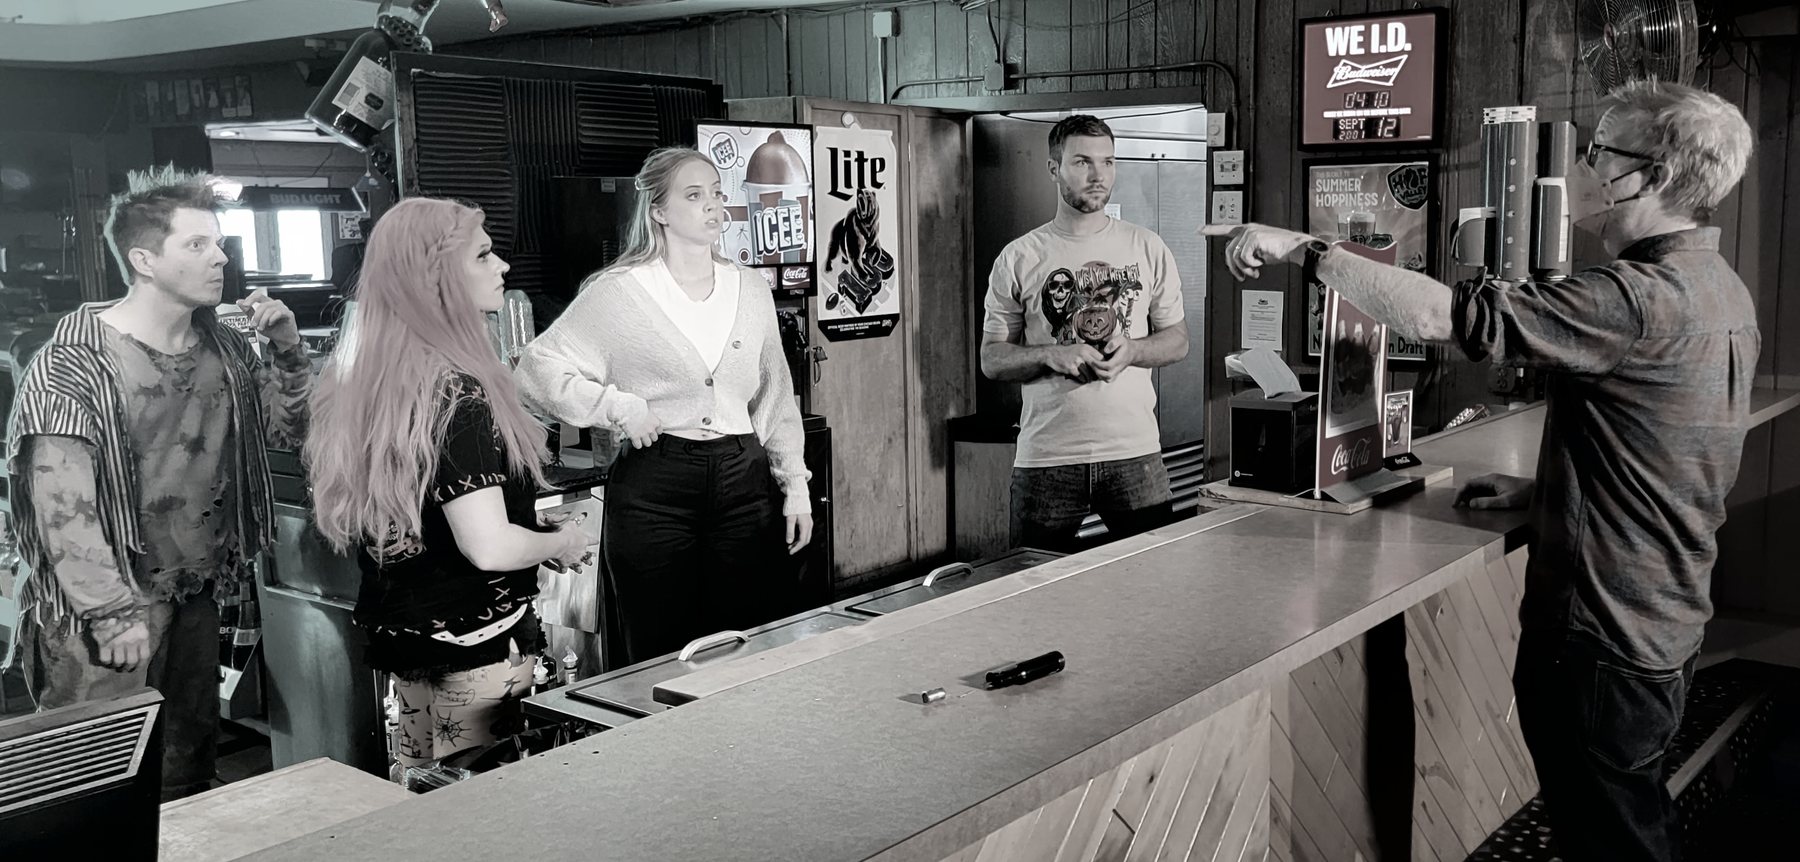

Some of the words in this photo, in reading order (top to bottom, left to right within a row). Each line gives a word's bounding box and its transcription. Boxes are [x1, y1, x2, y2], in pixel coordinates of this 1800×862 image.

[1325, 25, 1365, 56] WE
[1371, 22, 1412, 53] I.D.
[1333, 65, 1399, 80] Budweiser
[1339, 118, 1366, 130] SEPT
[1377, 117, 1396, 137] 12
[1339, 130, 1366, 140] 2001
[712, 138, 735, 165] ICEE
[826, 146, 886, 201] Lite
[1315, 178, 1361, 193] SUMMER
[269, 193, 300, 204] BUD
[301, 193, 341, 204] LIGHT
[1315, 193, 1378, 208] HOPPINESS
[752, 204, 806, 256] ICEE
[783, 267, 808, 280] Coca-Cola
[1397, 336, 1424, 355] Draft
[1331, 438, 1371, 475] Coca-Cola
